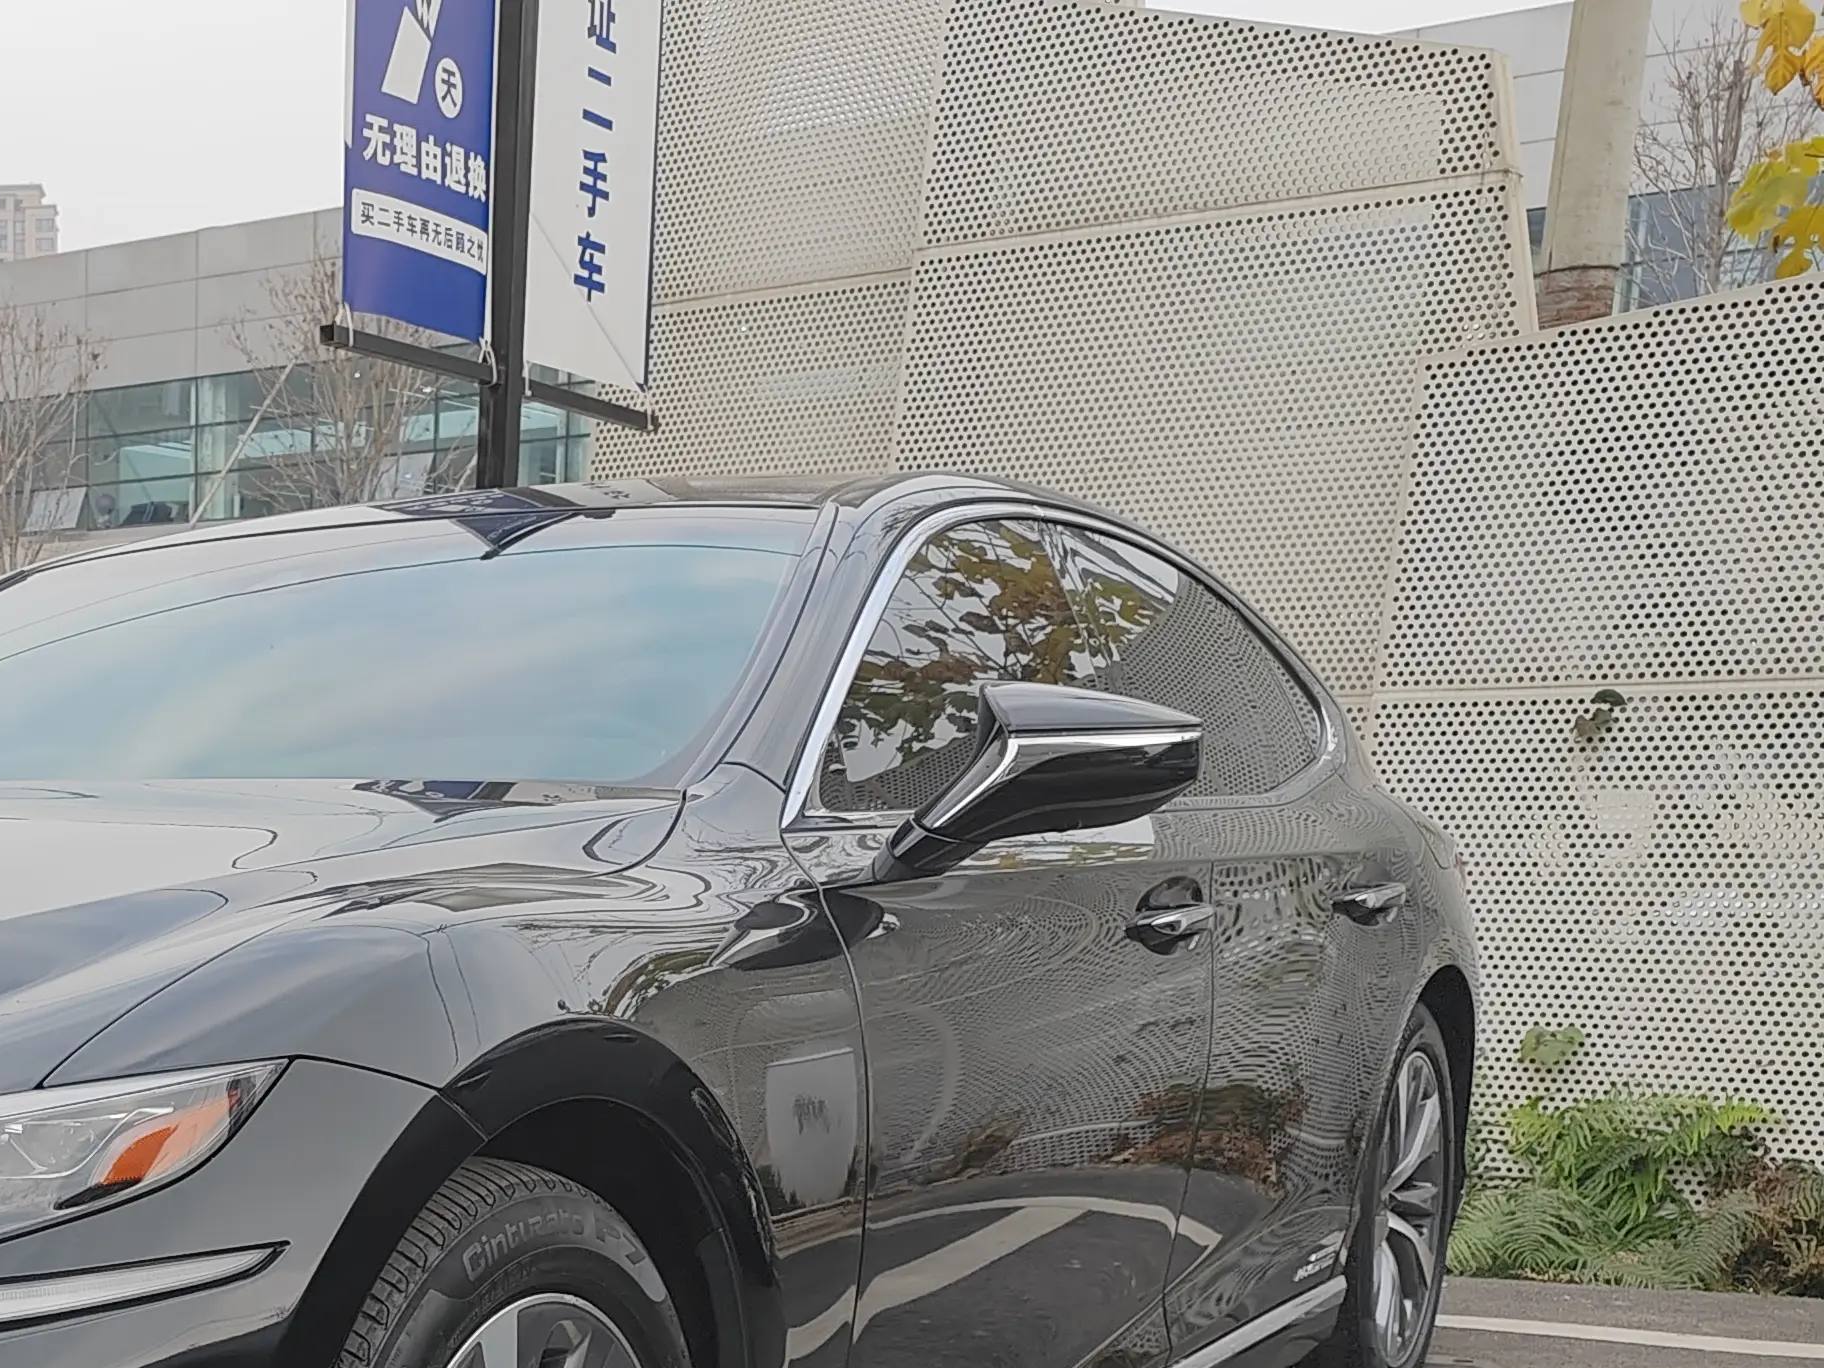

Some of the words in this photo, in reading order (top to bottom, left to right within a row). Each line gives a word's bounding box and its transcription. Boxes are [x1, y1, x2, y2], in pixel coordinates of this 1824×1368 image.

[441, 66, 457, 108] 天
[362, 113, 487, 203] 无理由退换
[360, 201, 485, 264] 买二手车再无后顾之忧
